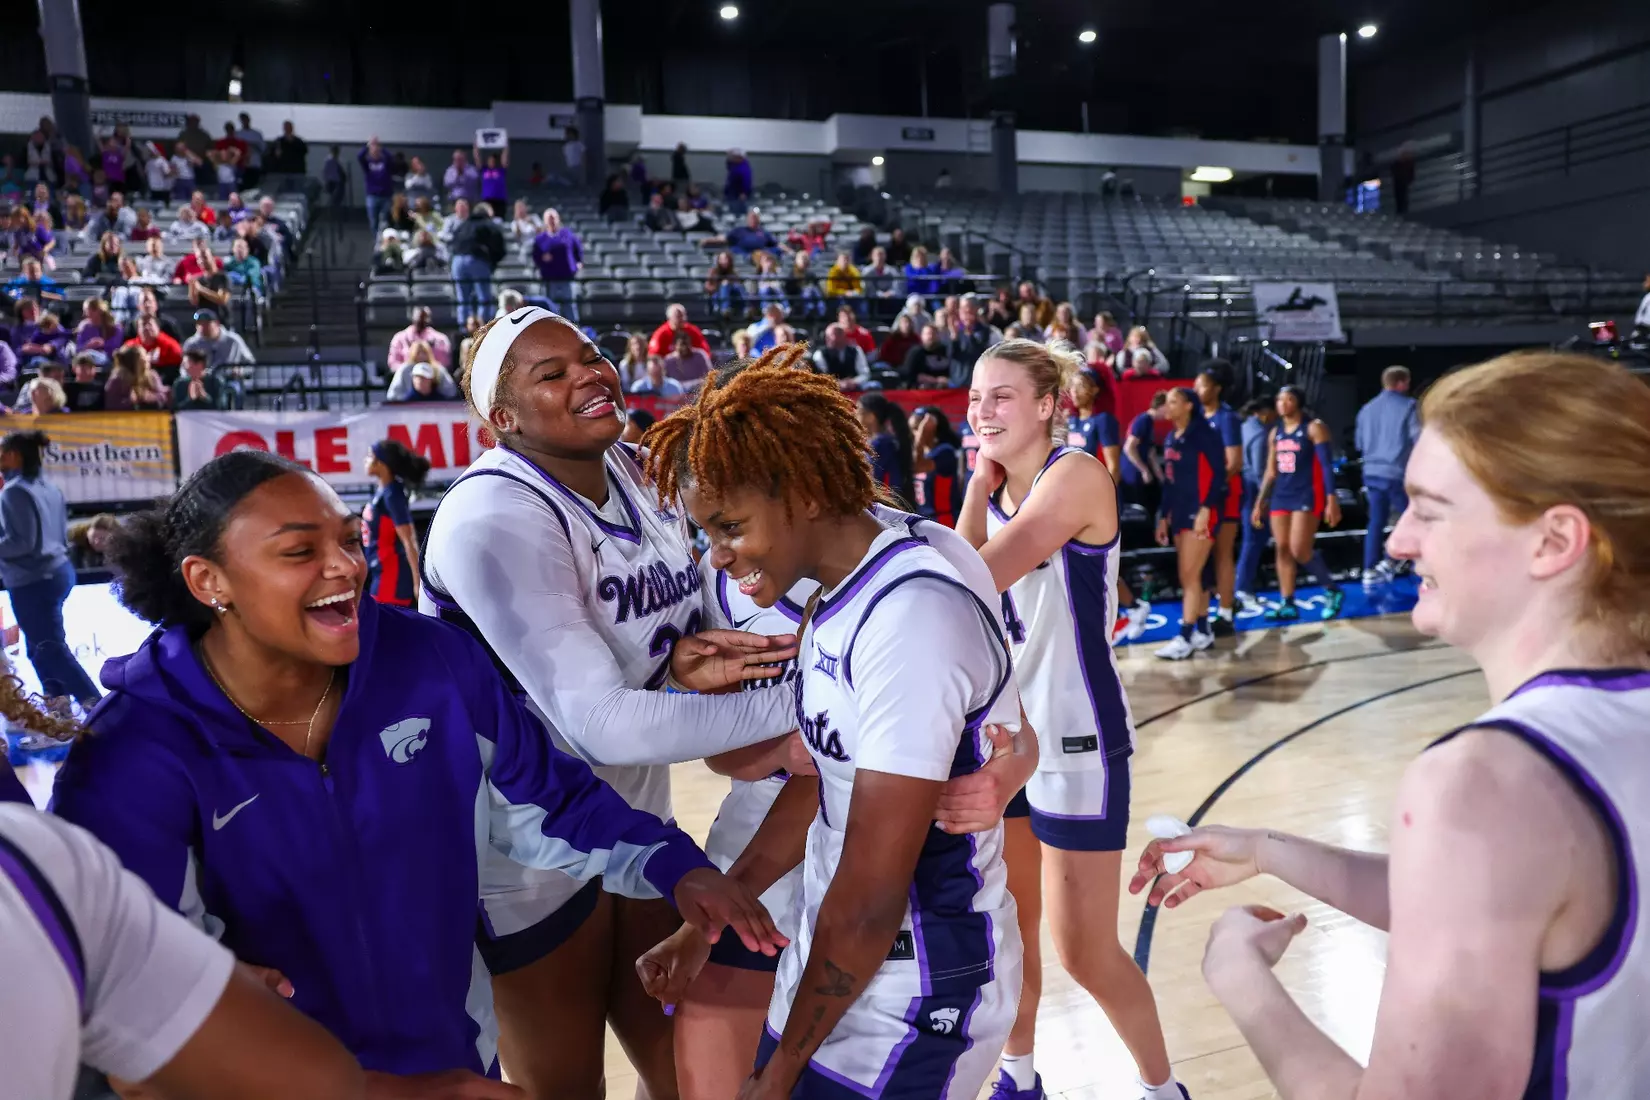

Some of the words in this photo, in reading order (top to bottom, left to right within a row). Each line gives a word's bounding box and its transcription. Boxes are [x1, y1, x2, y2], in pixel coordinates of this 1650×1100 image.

[89, 112, 186, 126] FRESHMENTS
[44, 443, 161, 463] Southern
[894, 940, 905, 951] M
